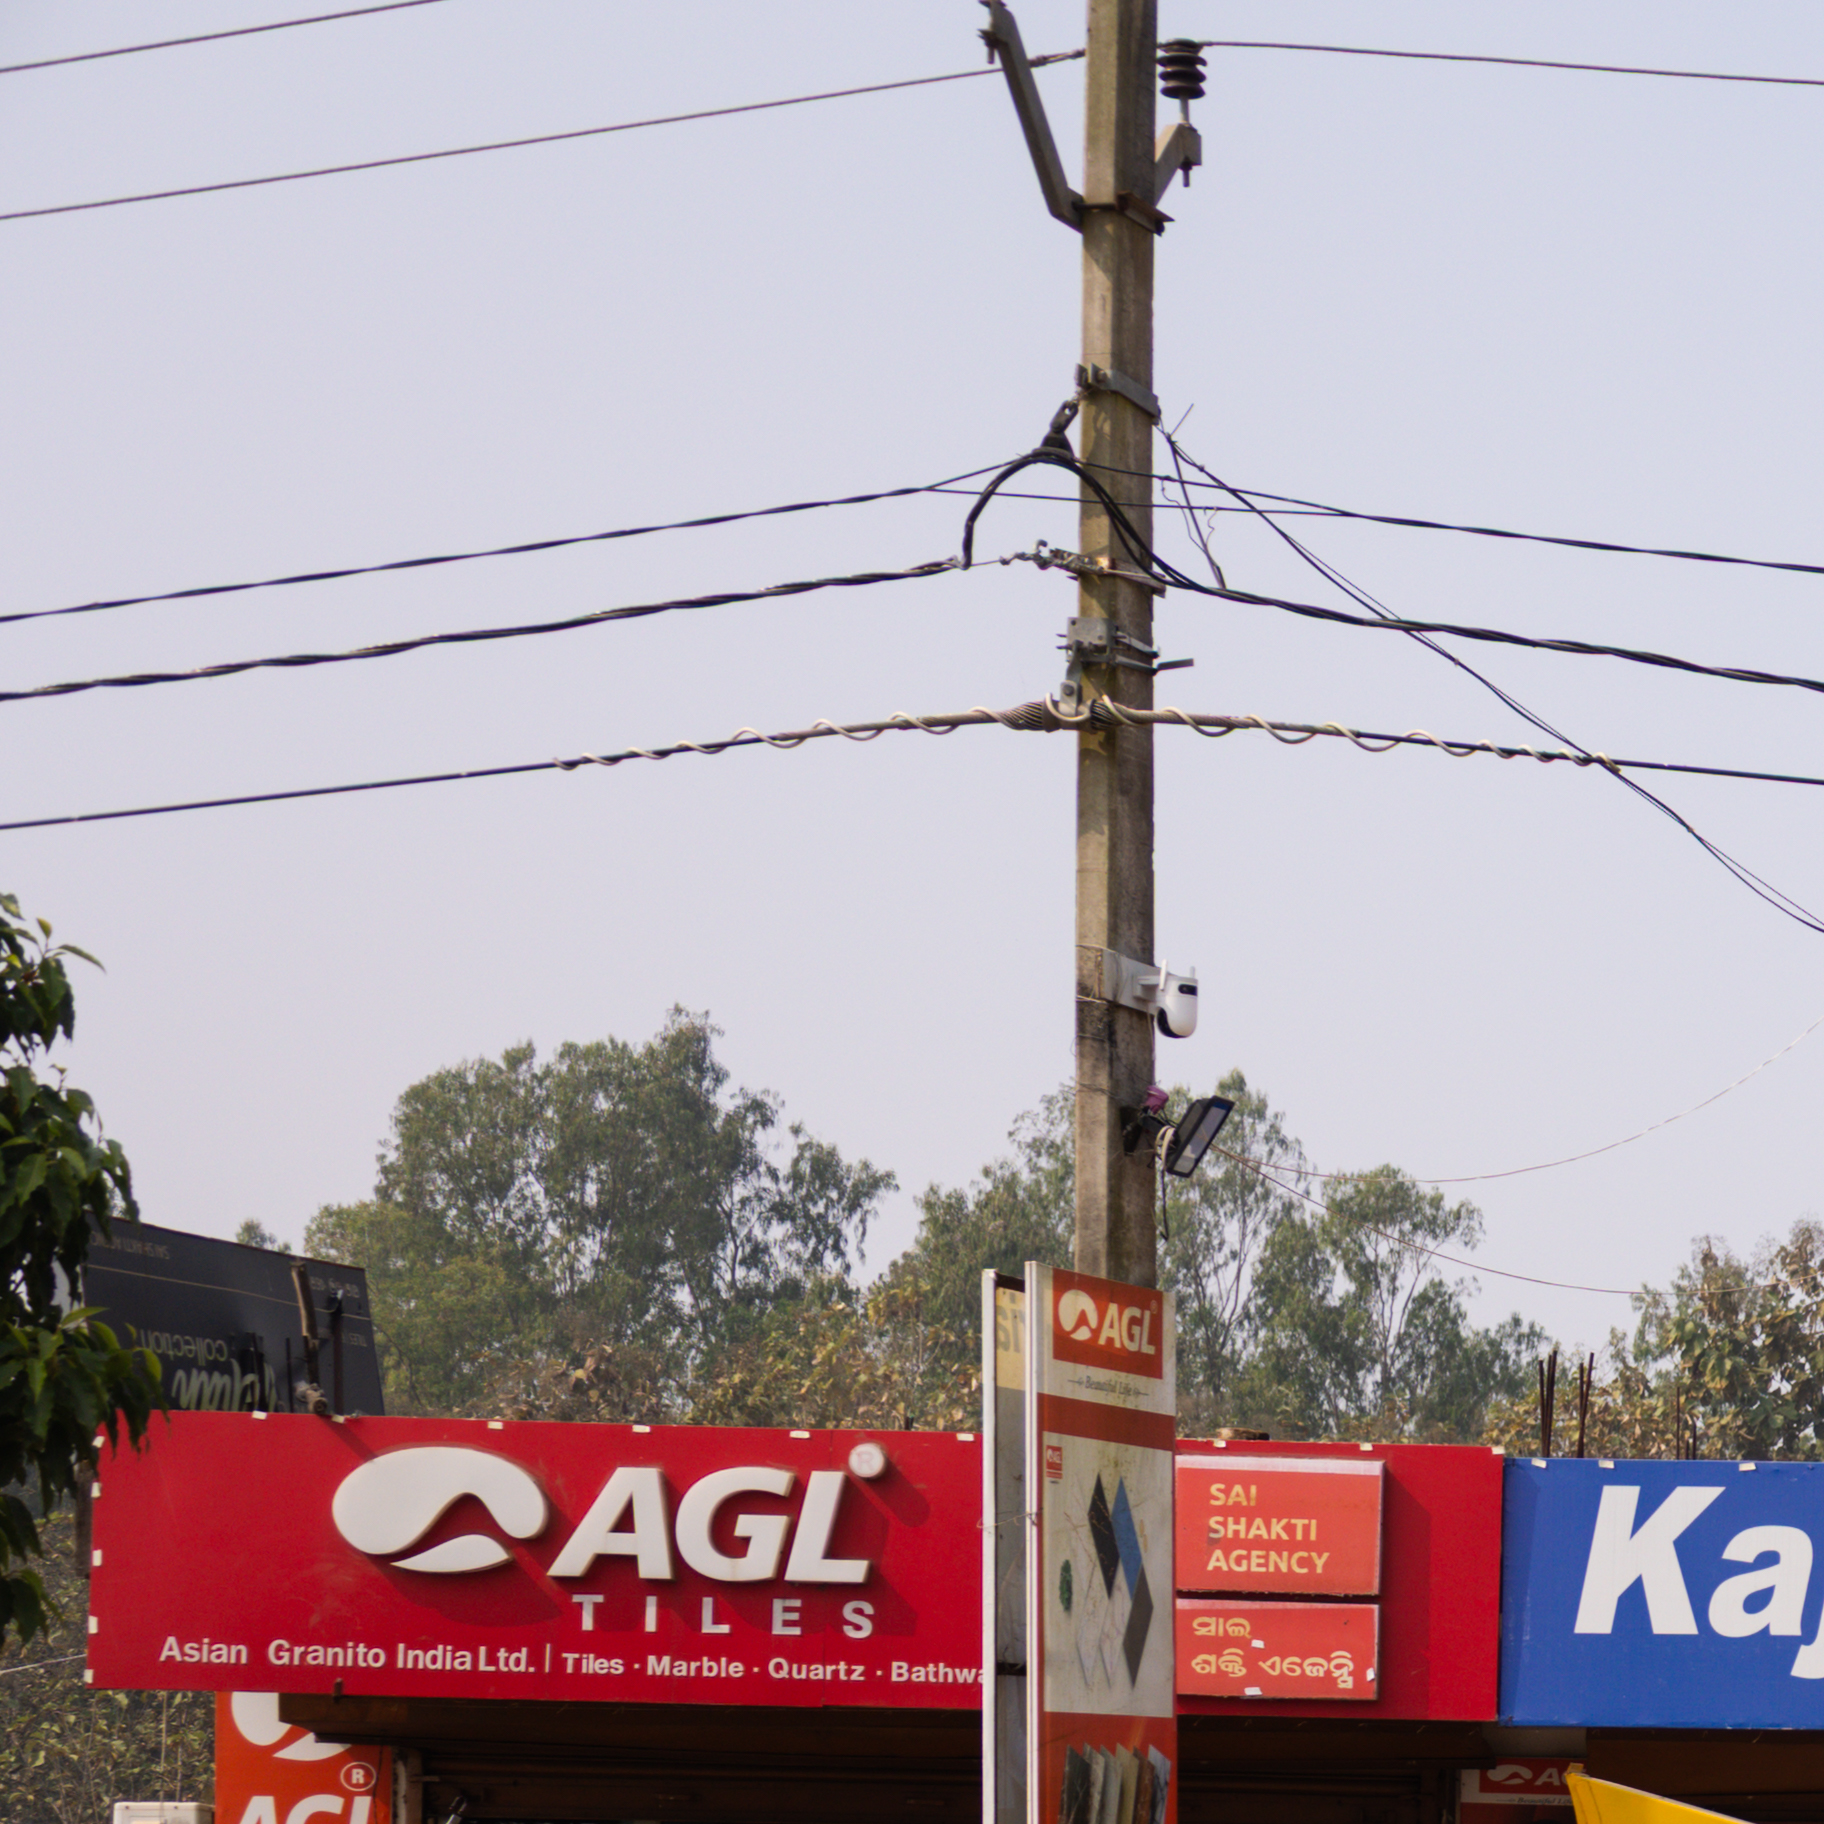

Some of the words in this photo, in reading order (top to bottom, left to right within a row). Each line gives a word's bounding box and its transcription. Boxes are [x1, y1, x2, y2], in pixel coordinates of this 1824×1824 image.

[139, 1329, 228, 1366] collection
[1098, 1302, 1156, 1355] AGL
[1210, 1483, 1257, 1506] SAI
[547, 1465, 870, 1584] AGL
[1208, 1516, 1317, 1541] SHAKTI
[1207, 1549, 1330, 1574] AGENCY
[572, 1593, 873, 1639] TILES
[1192, 1616, 1251, 1639] ସାଇ
[159, 1636, 247, 1666] Asian
[268, 1639, 386, 1672] Granito
[397, 1643, 473, 1671] India
[478, 1644, 536, 1674] Ltd.
[563, 1652, 625, 1677] Tiles
[646, 1655, 744, 1680] Marble
[768, 1657, 865, 1683] Quartz
[1191, 1648, 1247, 1678] ଶକ୍ତି
[1258, 1650, 1354, 1689] ଏଜେନ୍ସି
